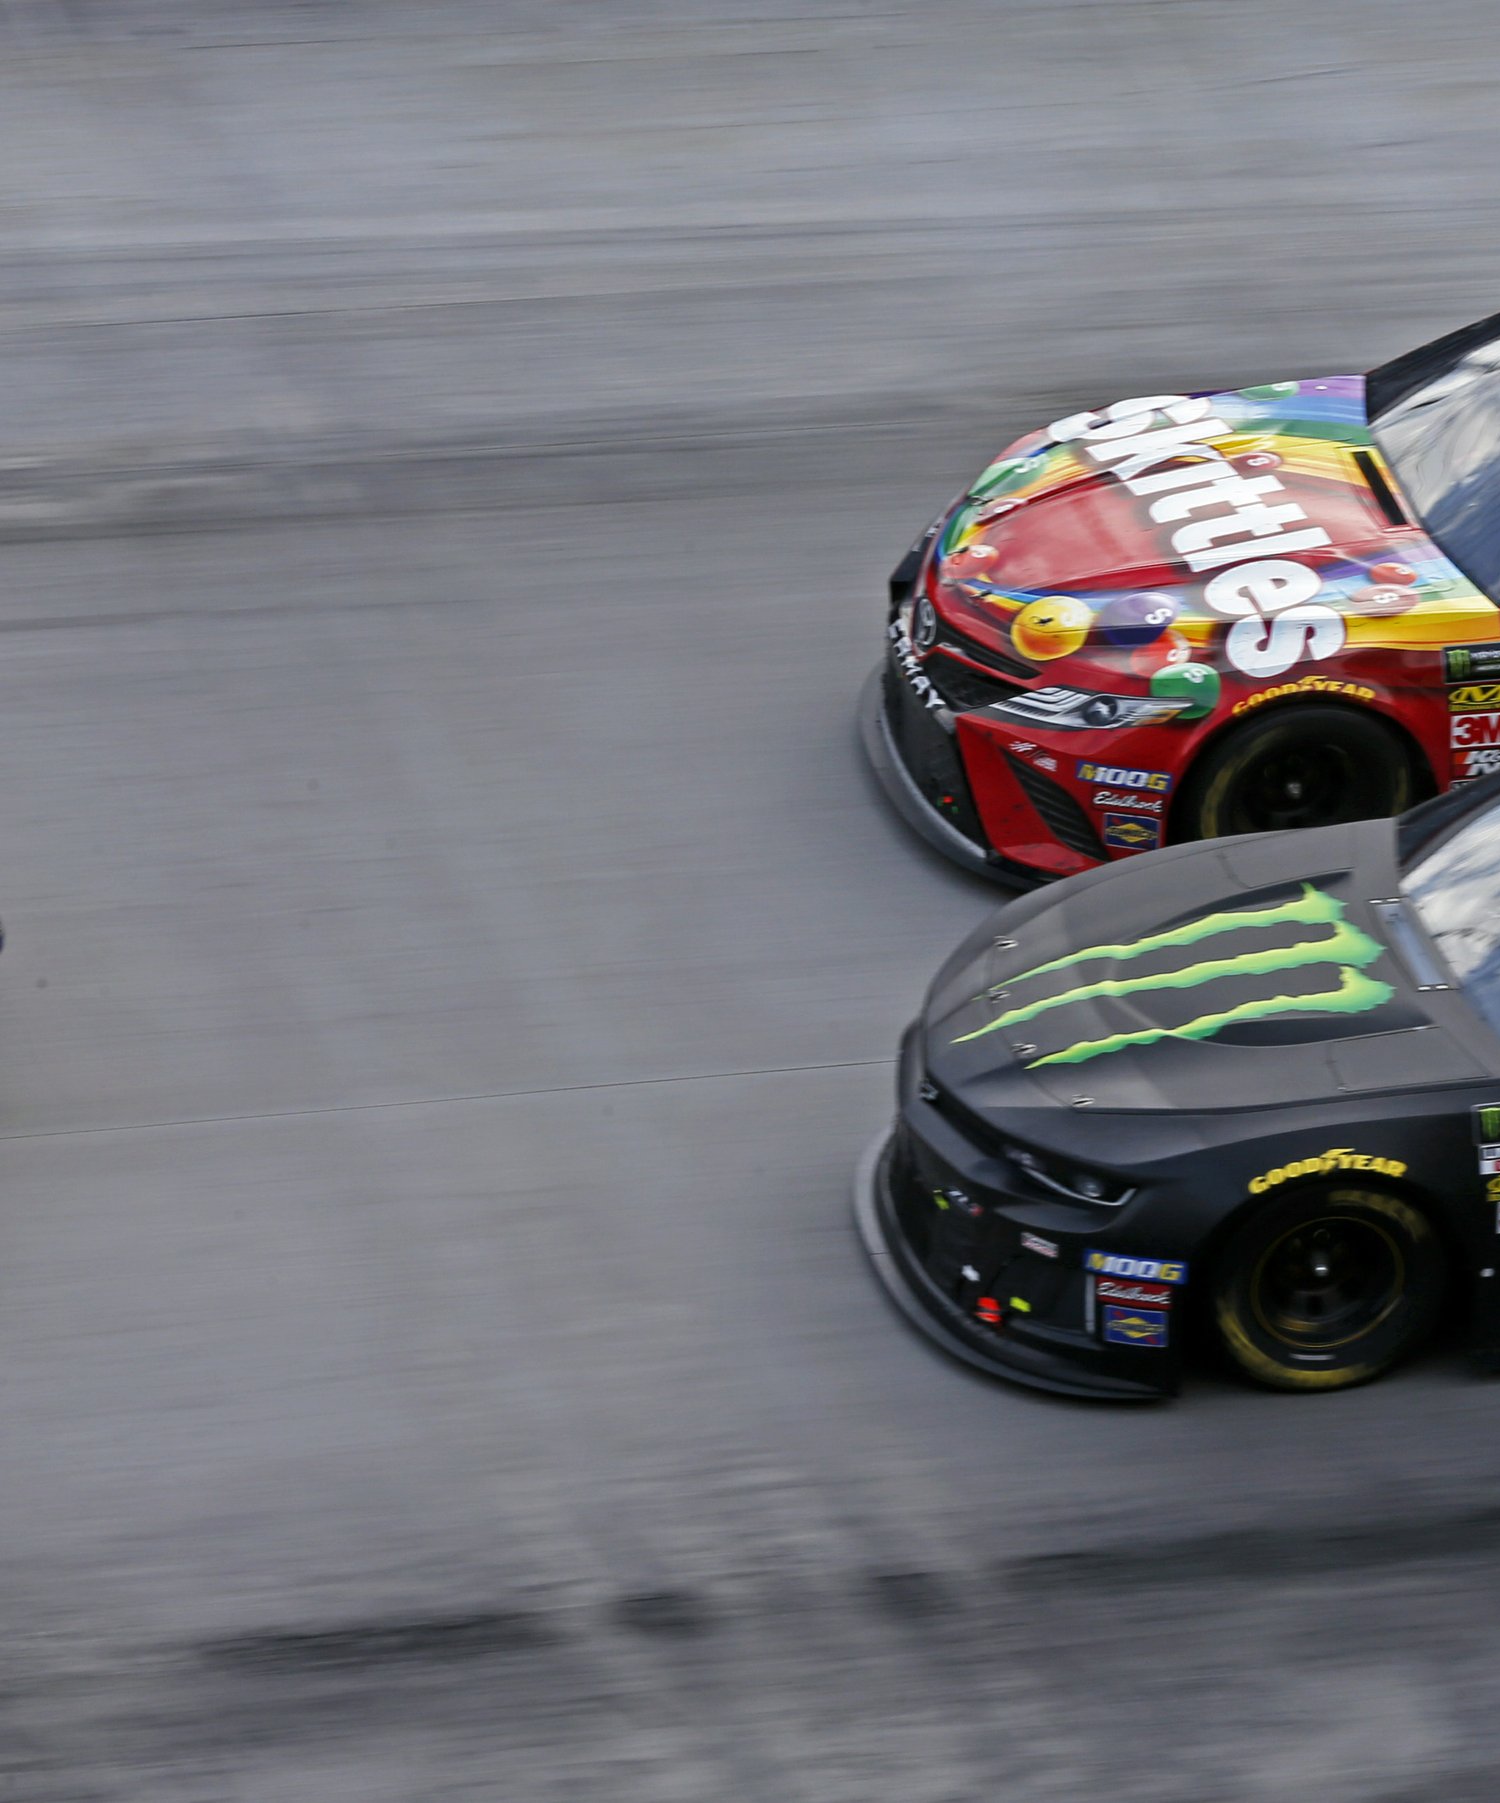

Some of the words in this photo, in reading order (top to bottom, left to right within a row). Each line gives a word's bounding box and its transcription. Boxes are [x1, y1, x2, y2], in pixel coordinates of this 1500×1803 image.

[1048, 395, 1346, 679] Skittles
[1231, 675, 1377, 716] GOODYEAR
[1077, 763, 1171, 791] MOOG
[1248, 1148, 1408, 1195] GOODYEAR
[1087, 1253, 1184, 1281] MOOG
